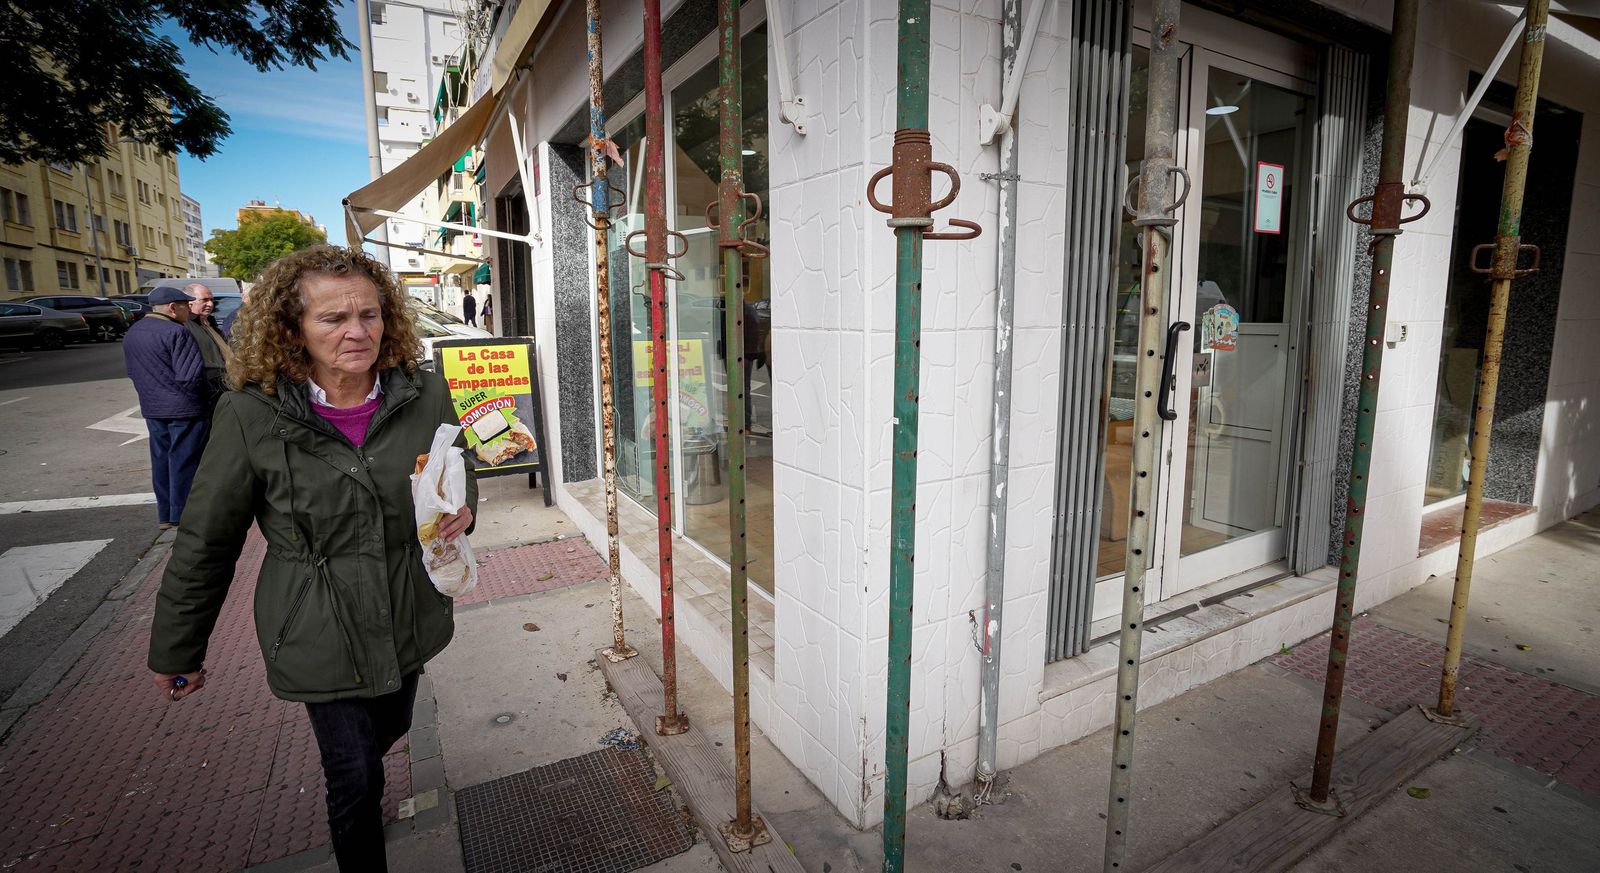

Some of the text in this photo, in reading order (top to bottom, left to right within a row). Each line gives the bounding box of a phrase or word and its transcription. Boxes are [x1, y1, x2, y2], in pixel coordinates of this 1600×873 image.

[459, 349, 515, 361] La Casa
[467, 362, 510, 374] de las
[448, 375, 529, 391] Empanadas
[460, 398, 511, 429] ROMOCIÓN
